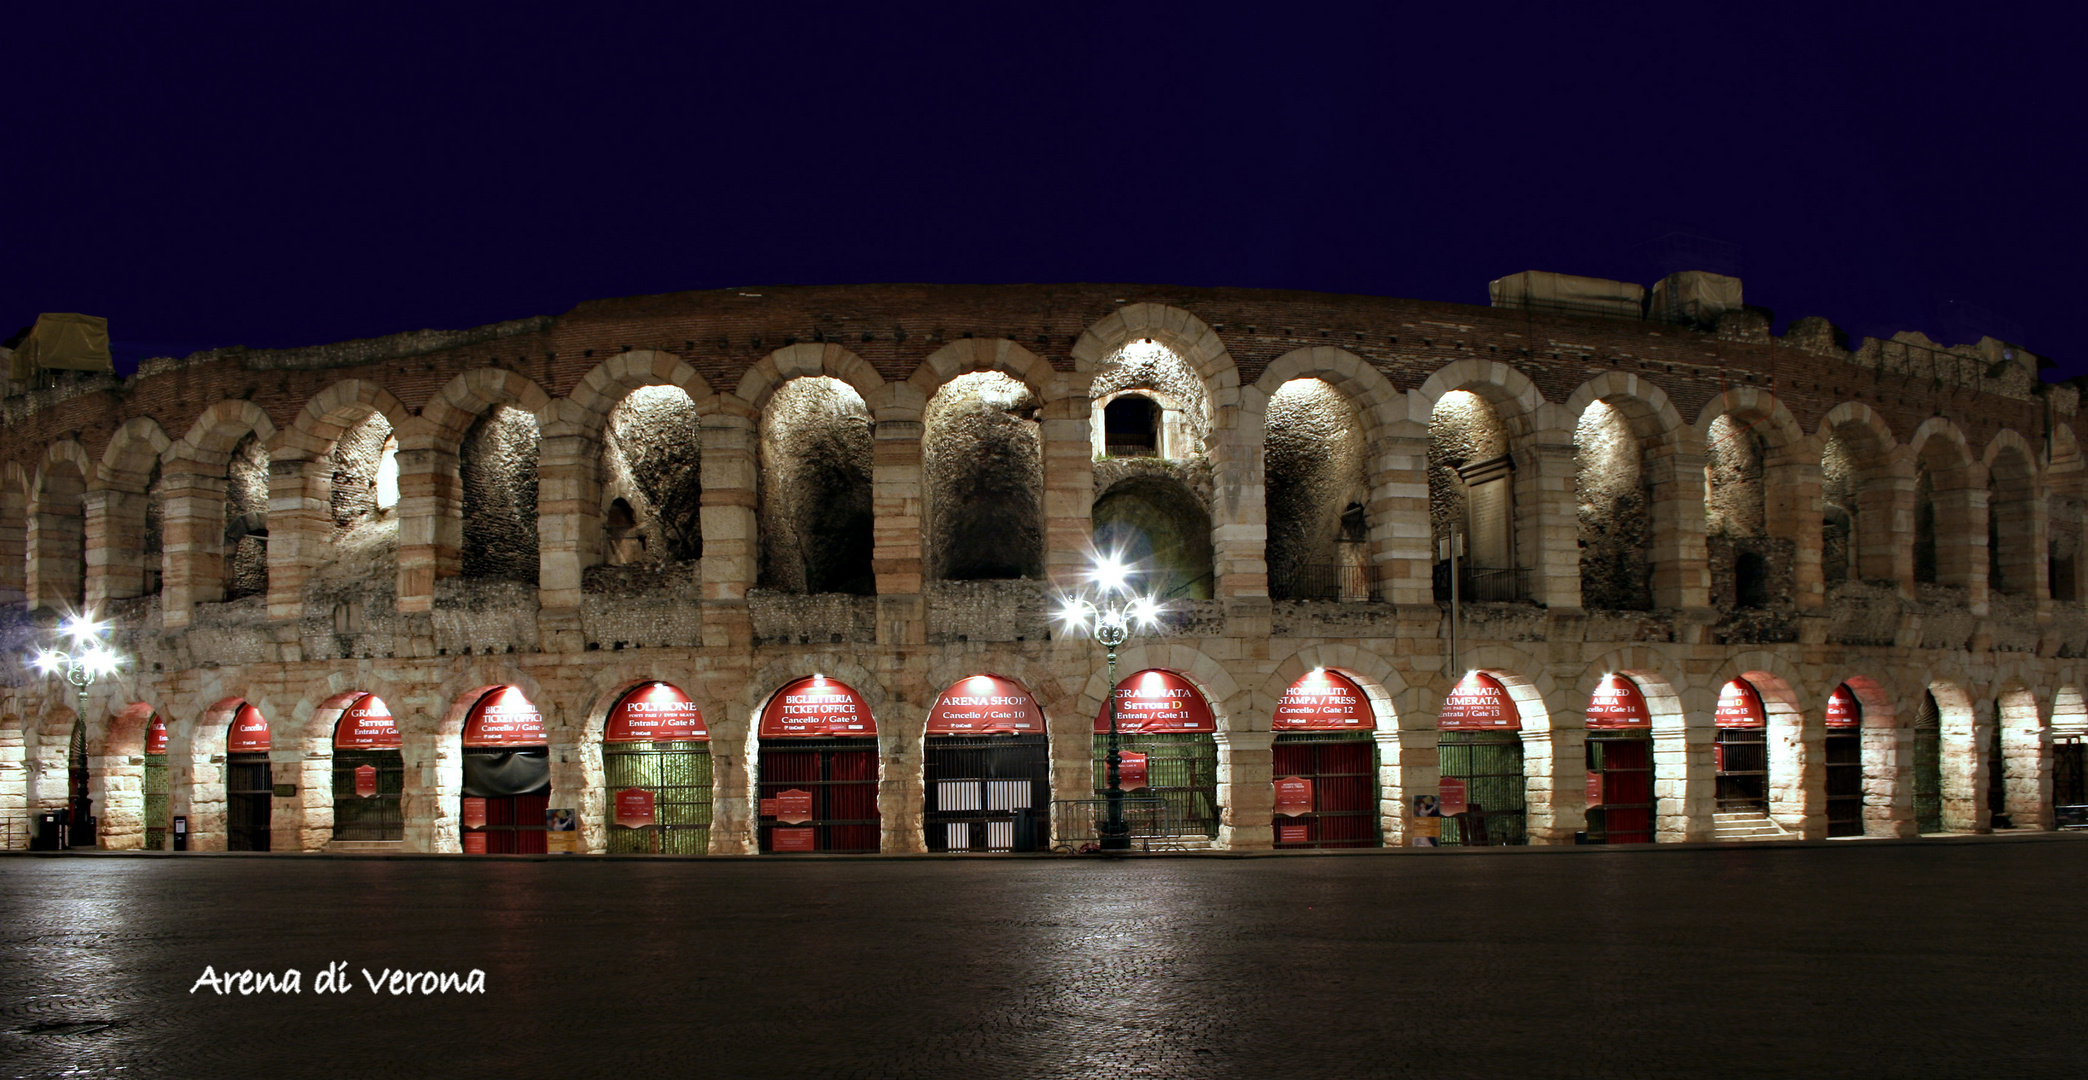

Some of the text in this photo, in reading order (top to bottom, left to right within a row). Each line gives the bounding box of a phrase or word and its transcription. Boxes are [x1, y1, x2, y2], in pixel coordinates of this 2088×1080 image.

[1114, 689, 1192, 698] GRANATA
[1449, 687, 1501, 696] ADINATA
[942, 696, 1026, 705] ARENA SHOP
[1278, 696, 1356, 705] STAMPA / PRESS
[1444, 697, 1500, 705] UMERATA
[783, 704, 856, 714] TICKET OFFICE
[1124, 701, 1182, 710] SETTORE D
[689, 718, 695, 726] 8
[781, 716, 820, 724] Cancello
[851, 715, 858, 723] 9
[481, 724, 514, 732] Cancello
